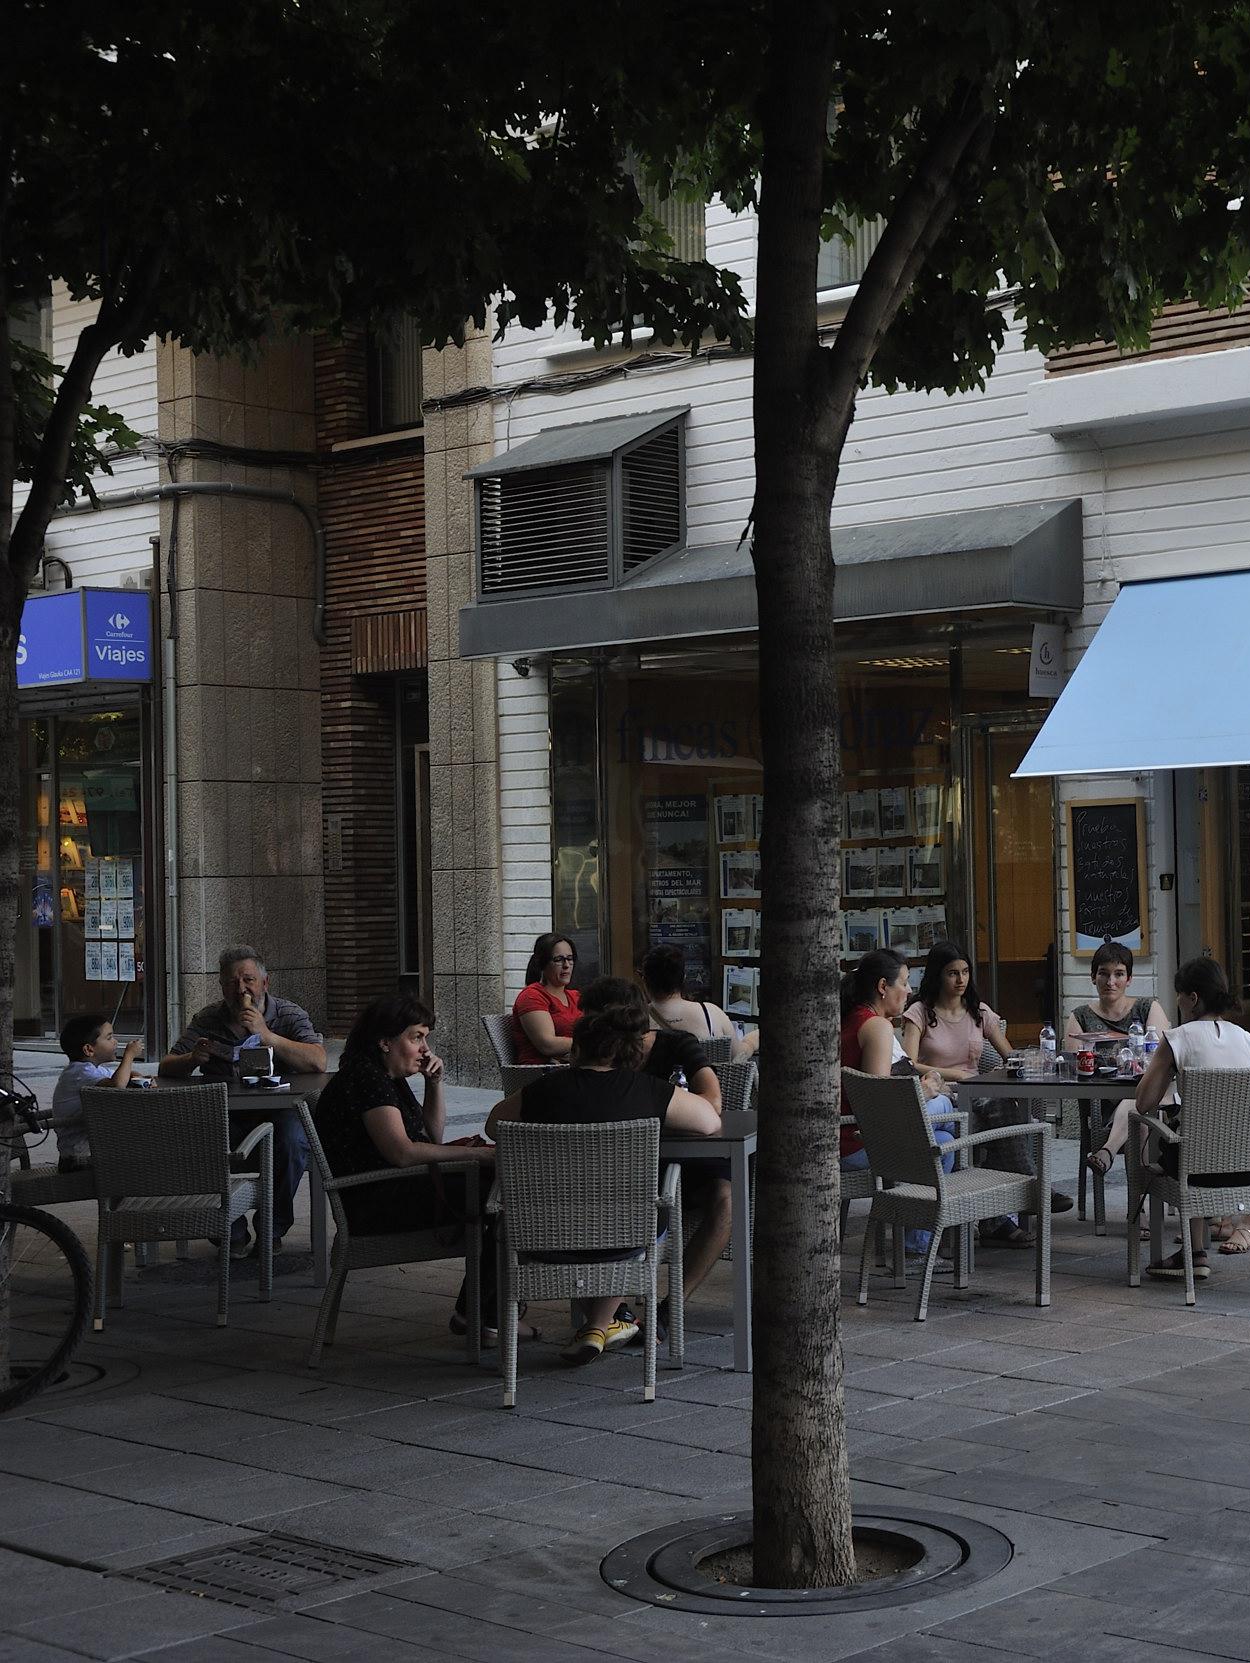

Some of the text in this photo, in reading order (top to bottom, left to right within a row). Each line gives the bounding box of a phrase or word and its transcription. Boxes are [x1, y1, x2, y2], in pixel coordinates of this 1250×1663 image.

[95, 645, 146, 665] Viajes
[1035, 667, 1058, 677] huesca
[618, 706, 737, 764] fincas
[665, 800, 697, 808] MEJOR
[671, 879, 684, 887] DEL
[685, 879, 702, 887] MAR
